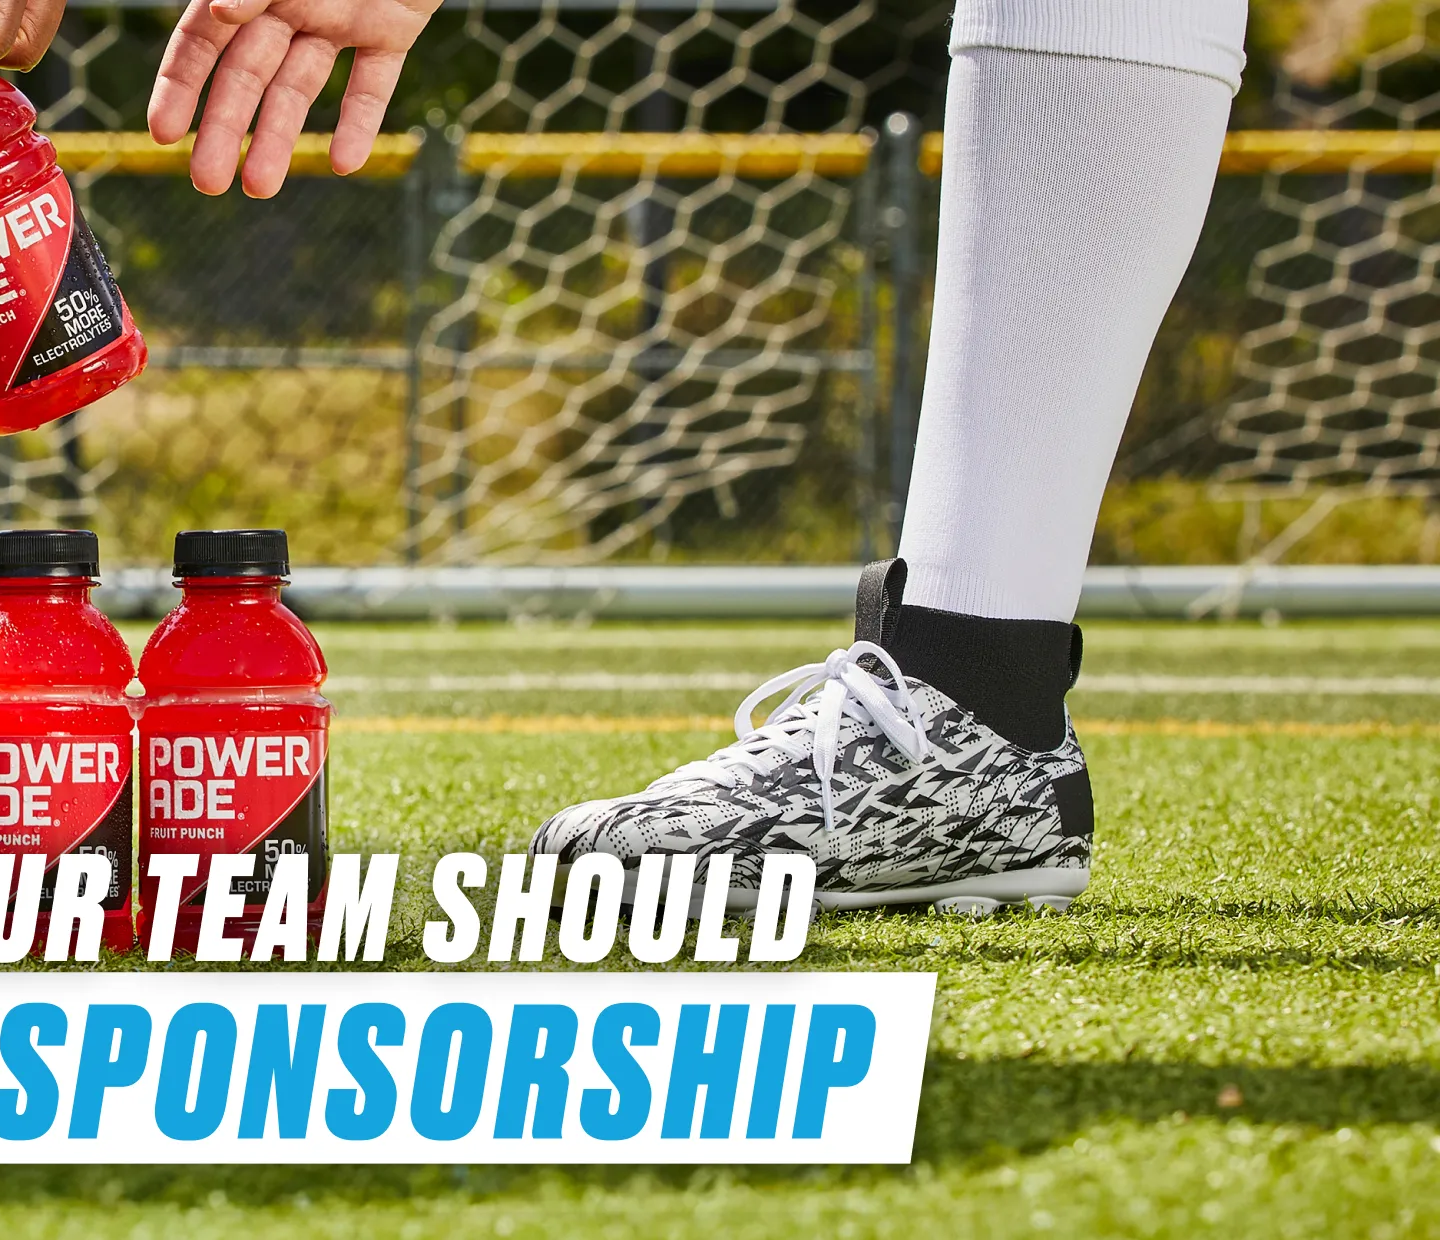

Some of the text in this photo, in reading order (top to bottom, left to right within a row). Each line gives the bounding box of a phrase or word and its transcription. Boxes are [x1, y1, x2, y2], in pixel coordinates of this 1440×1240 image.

[54, 288, 100, 322] 50%
[63, 303, 107, 338] MORE
[150, 735, 311, 777] POWER
[150, 827, 225, 840] FRUIT PUNCH
